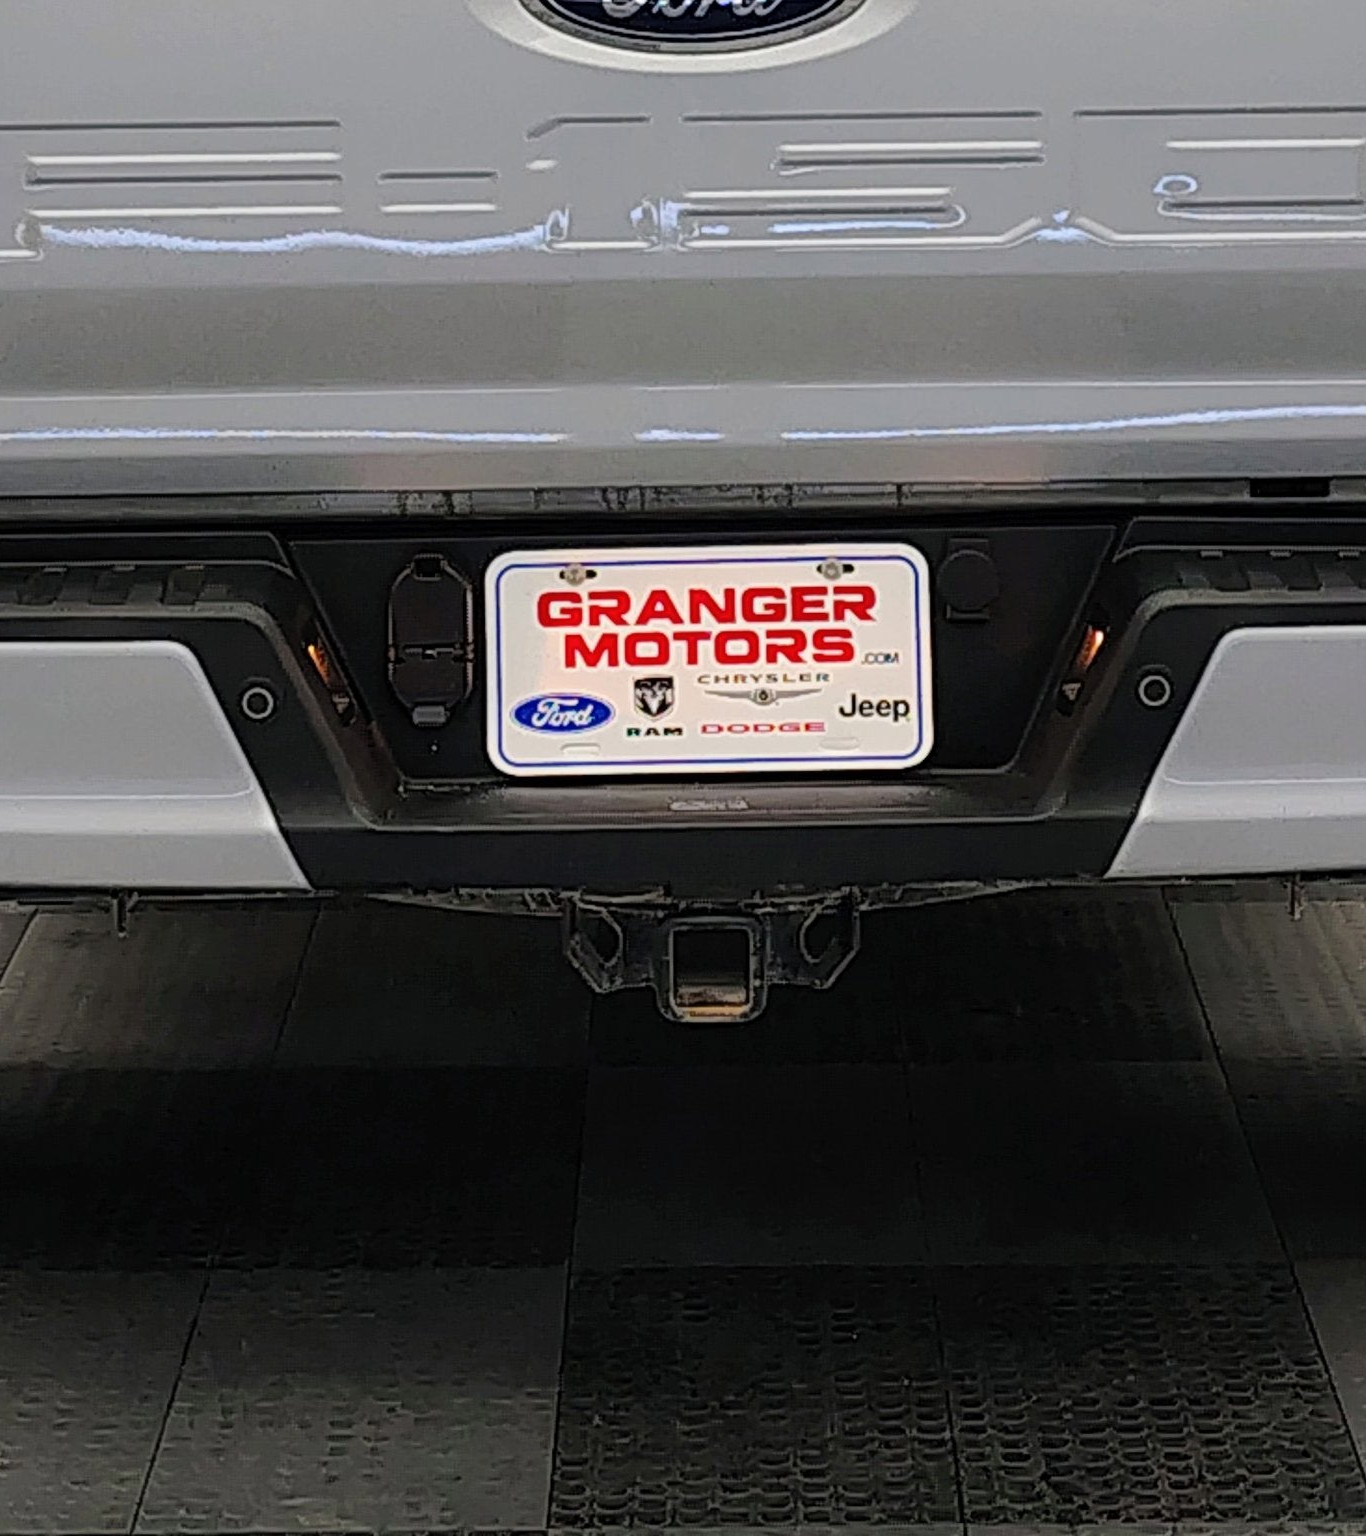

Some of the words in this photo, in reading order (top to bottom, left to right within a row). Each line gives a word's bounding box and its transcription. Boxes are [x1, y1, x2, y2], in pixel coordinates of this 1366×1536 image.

[537, 585, 877, 628] GRANGER
[564, 629, 855, 668] MOTORS
[697, 672, 831, 685] CHRYSLER
[530, 697, 595, 727] Ford
[838, 692, 910, 723] Jeep
[626, 727, 684, 737] RAM
[700, 721, 826, 735] DODGE
